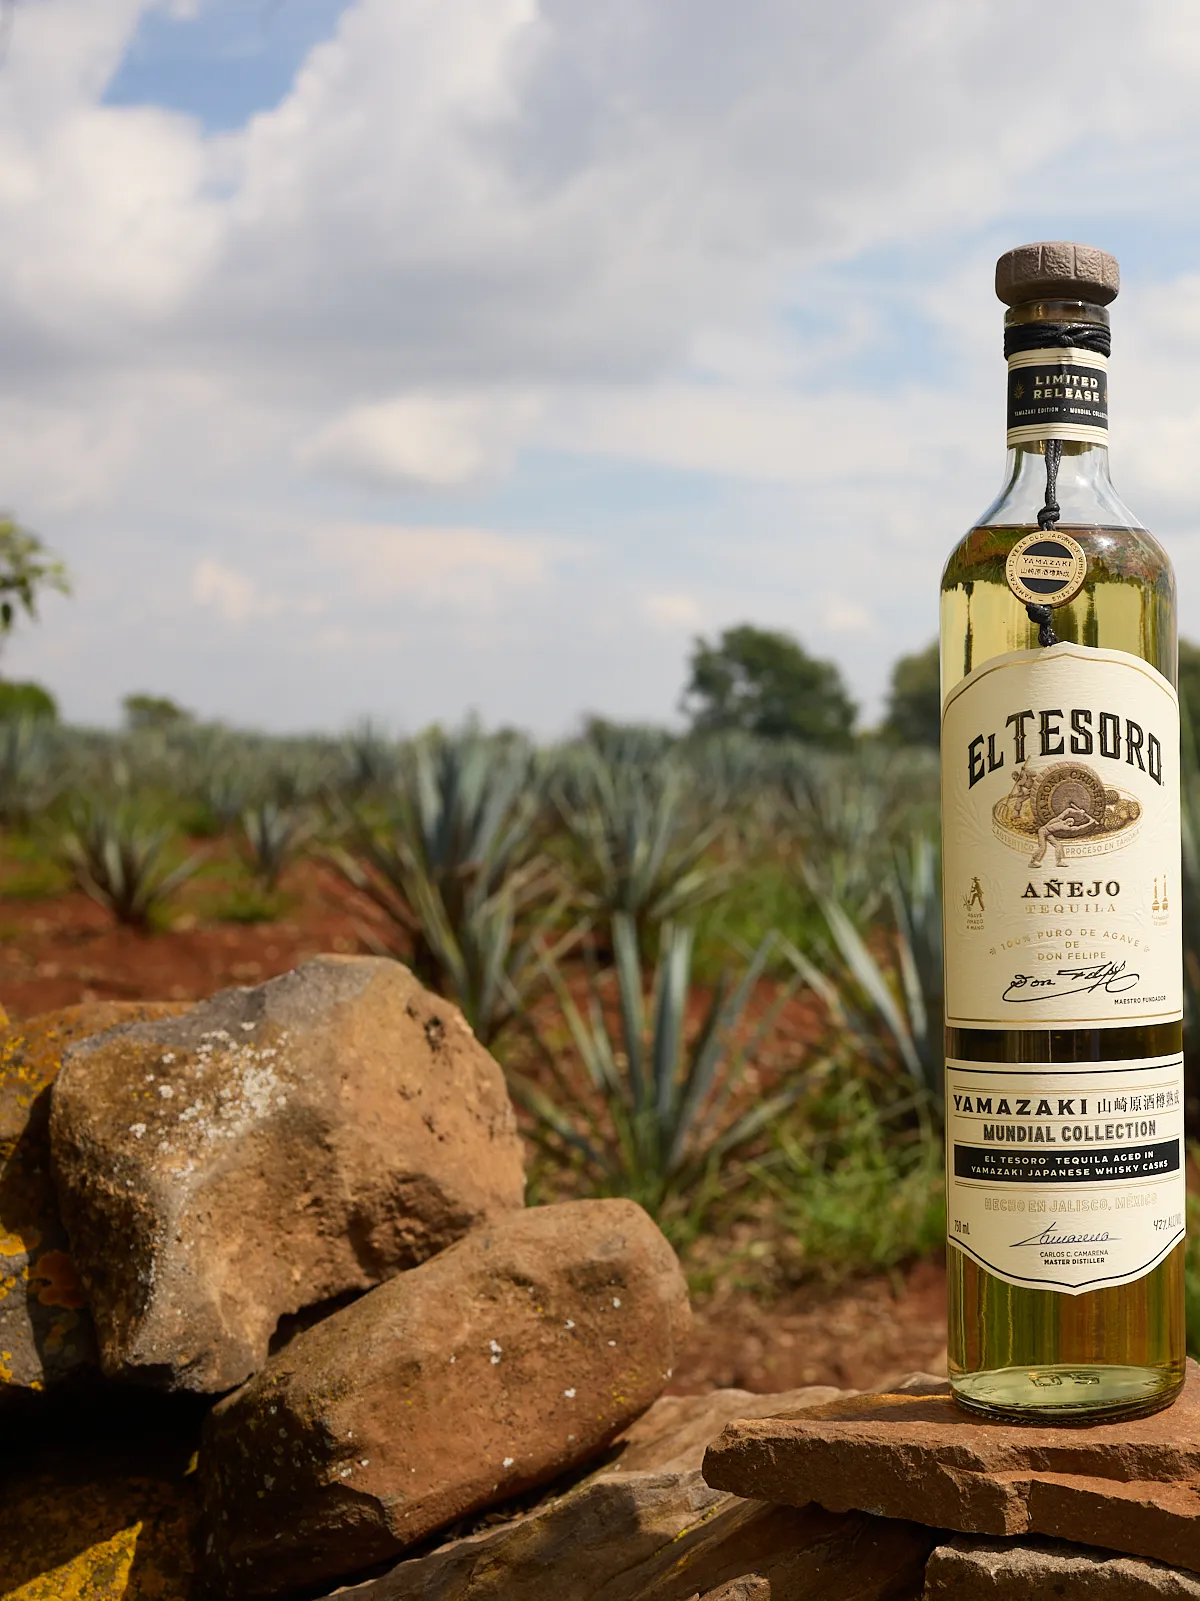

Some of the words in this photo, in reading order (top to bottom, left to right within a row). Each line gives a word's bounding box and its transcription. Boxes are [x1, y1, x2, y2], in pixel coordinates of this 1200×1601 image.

[1035, 375, 1098, 388] LIMITED
[1034, 388, 1100, 401] RELEASE
[1029, 533, 1045, 541] OLD
[1023, 558, 1072, 567] YAMAZAKI
[967, 734, 1004, 789] EL
[1005, 709, 1163, 786] TESORO
[1041, 774, 1065, 819] TAHONA
[1071, 771, 1102, 816] CRUSHED
[1066, 846, 1102, 855] PROCESO
[1021, 879, 1121, 898] AÑEJO
[1025, 903, 1117, 914] TEQUILA
[1001, 935, 1031, 950] 100%
[1038, 929, 1073, 939] PURO
[1081, 929, 1096, 937] DE
[1103, 931, 1140, 946] AGAVE
[1068, 952, 1107, 960] FELIPE
[953, 1095, 1087, 1115] YAMAZAKI
[983, 1124, 1056, 1142] MUNDIAL
[1061, 1120, 1157, 1142] COLLECTION
[1056, 1156, 1109, 1164] TEQUILA
[1114, 1153, 1141, 1162] AGED
[1144, 1151, 1154, 1159] IN
[971, 1166, 1023, 1176] YAMAZAKI
[1095, 1165, 1139, 1175] WHISKY
[1143, 1160, 1168, 1170] CASKS
[985, 1198, 1026, 1211] HECHO
[1029, 1201, 1046, 1212] EN
[1050, 1199, 1112, 1212] JALISCO,
[1116, 1193, 1157, 1209] MÉXICO
